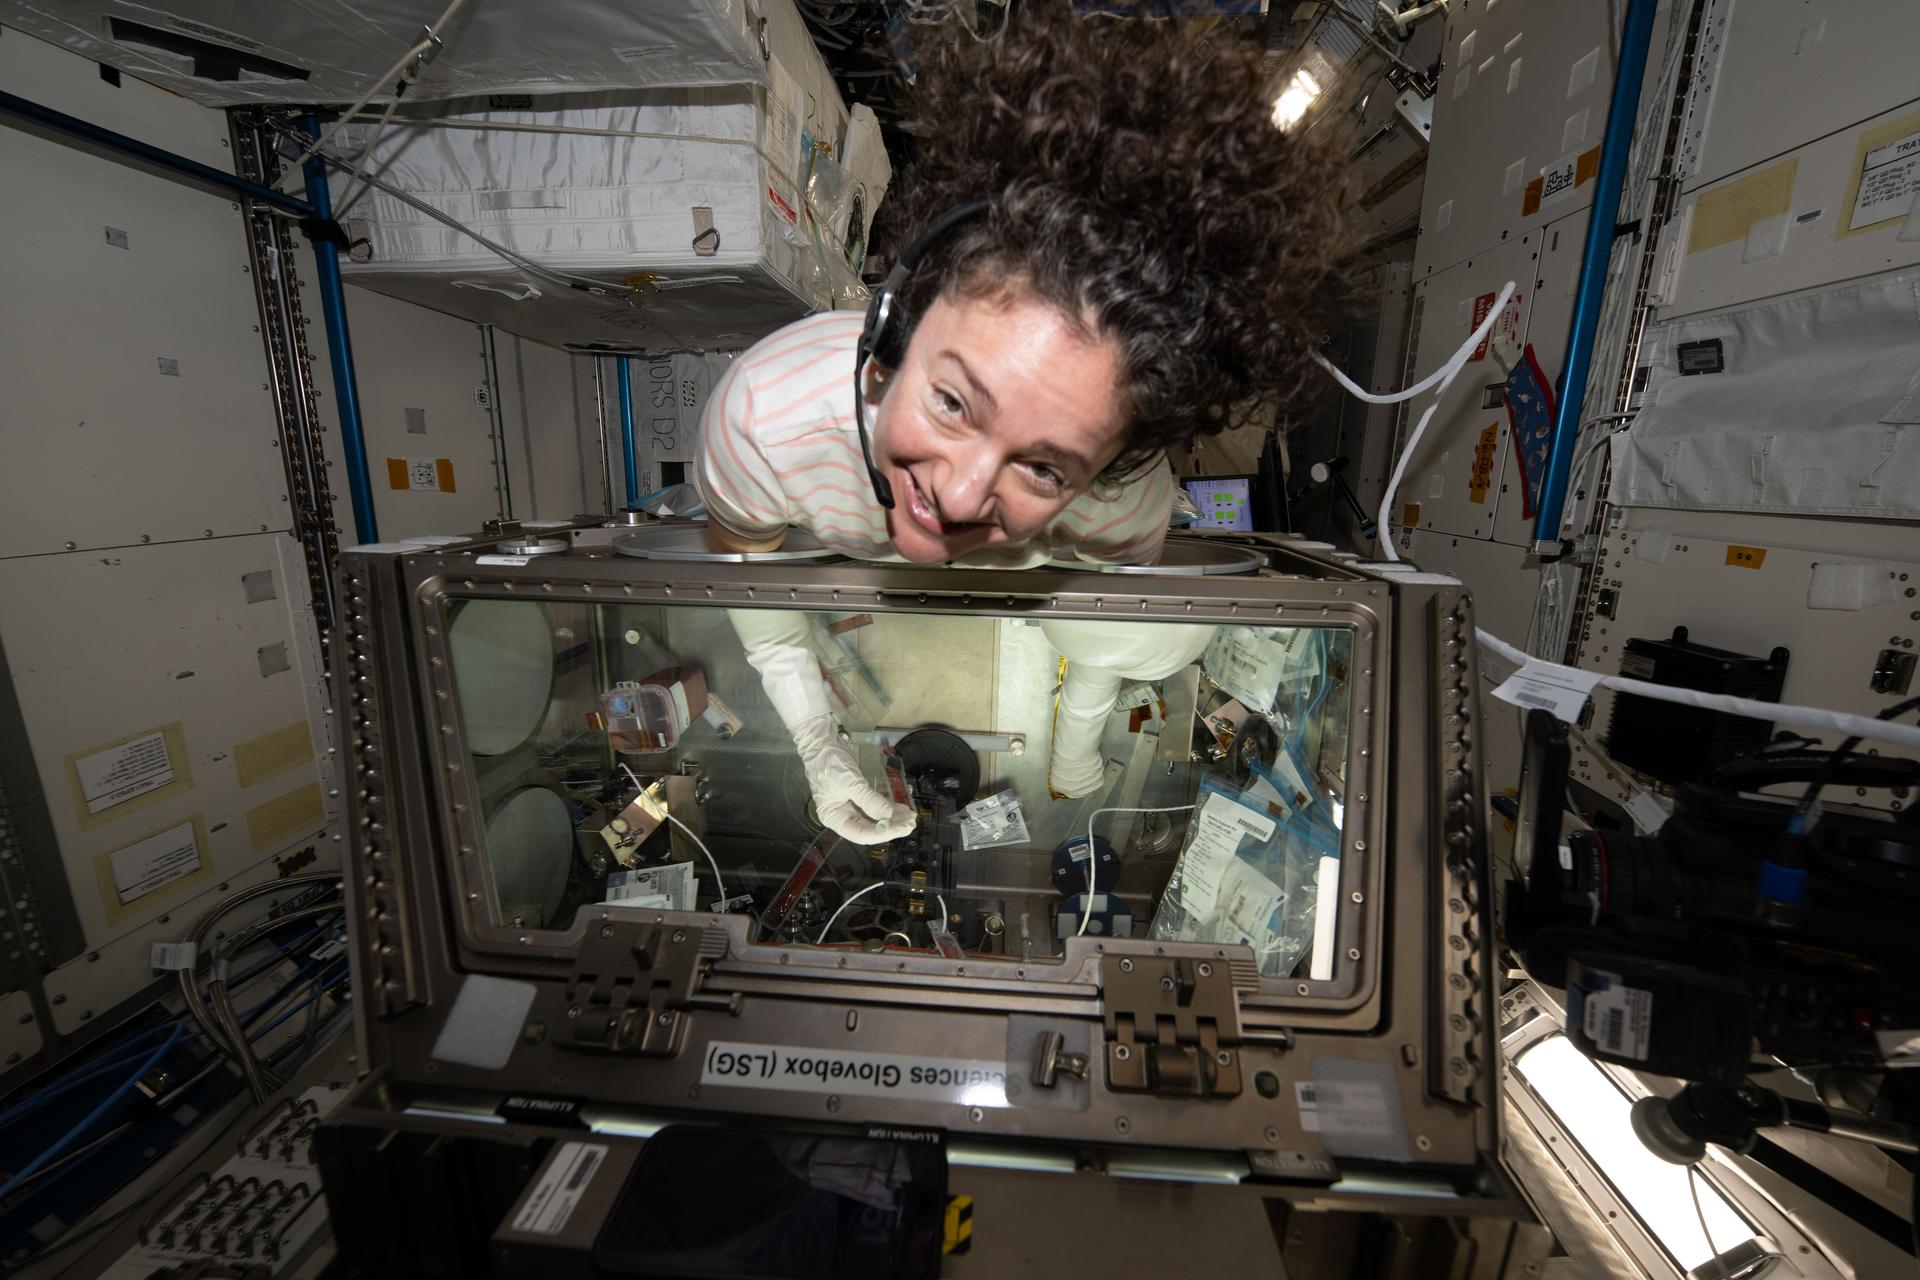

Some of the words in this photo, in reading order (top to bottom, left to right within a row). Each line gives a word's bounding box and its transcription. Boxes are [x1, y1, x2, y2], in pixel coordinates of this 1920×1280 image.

[651, 417, 676, 451] D2
[708, 1046, 777, 1079] (LSG)
[785, 1056, 900, 1087] Glovebox
